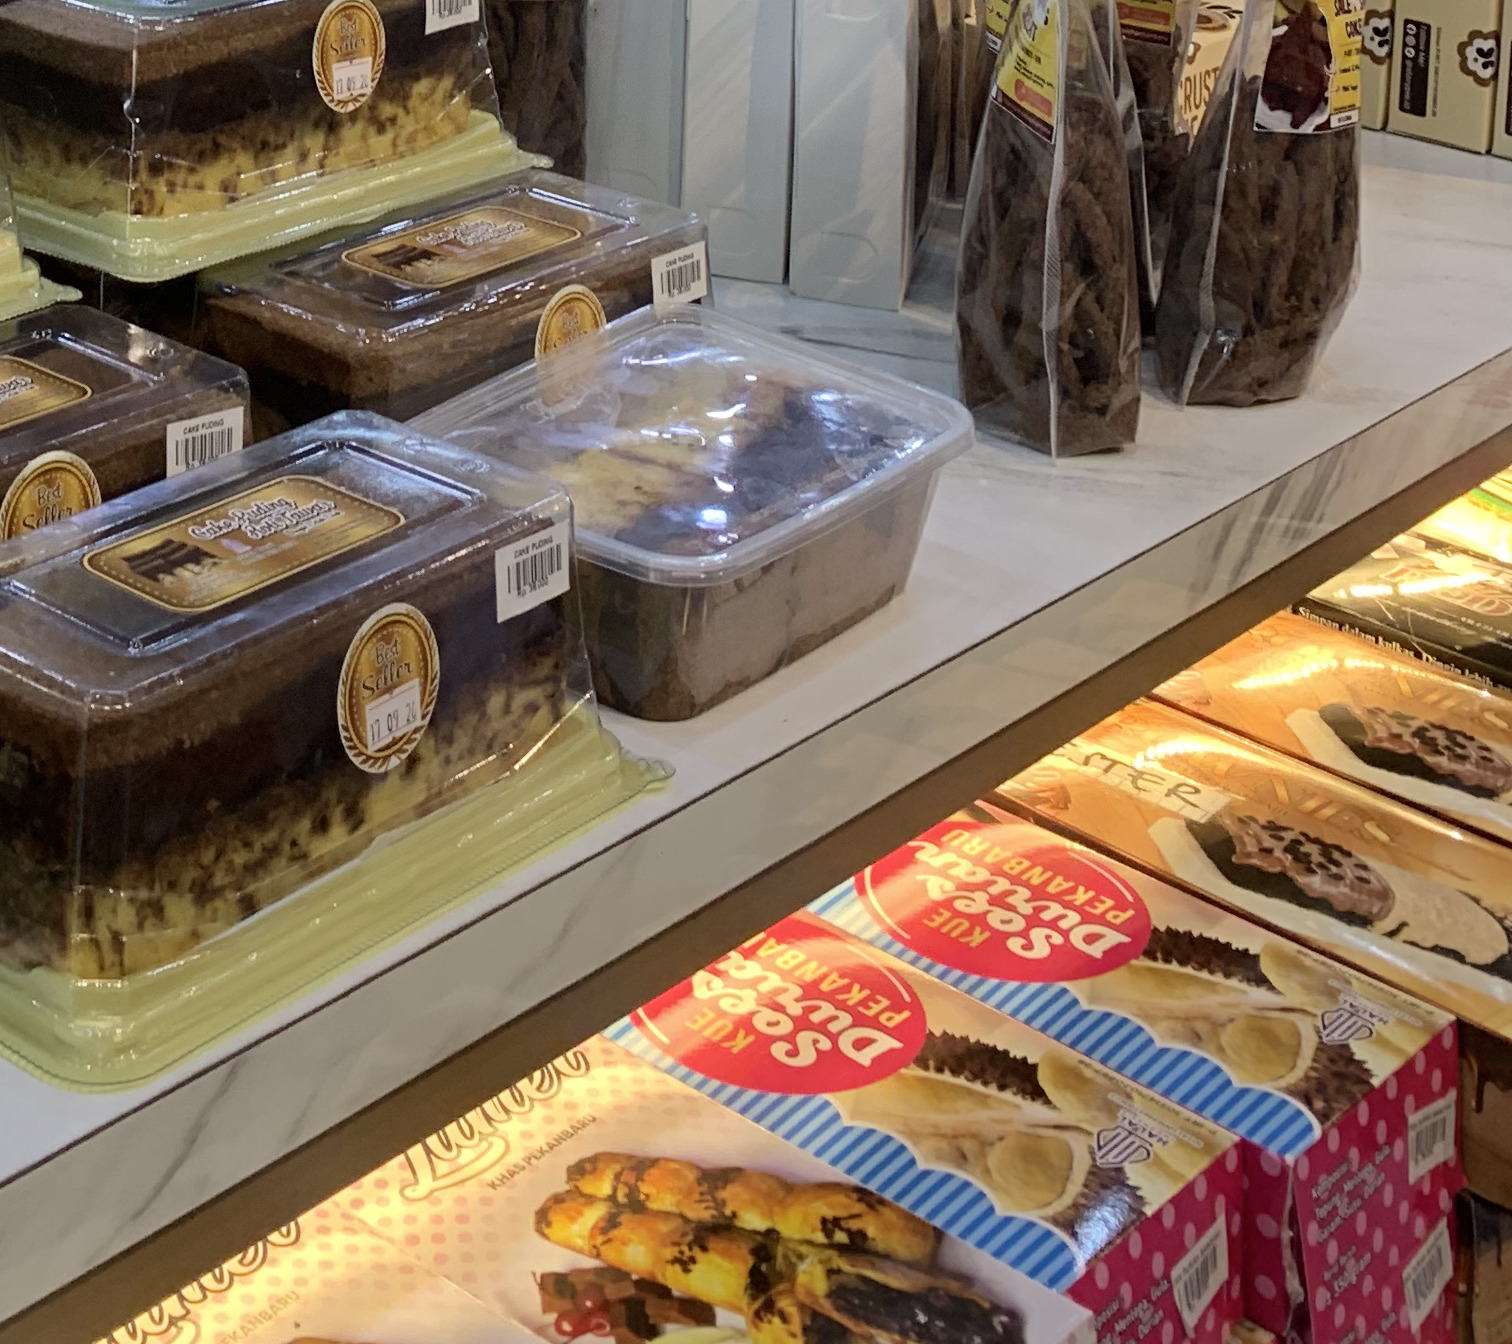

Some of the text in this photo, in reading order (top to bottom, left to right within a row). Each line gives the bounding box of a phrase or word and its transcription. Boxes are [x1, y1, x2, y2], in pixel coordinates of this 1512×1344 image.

[182, 417, 225, 437] CAKE PUDING
[35, 483, 64, 508] Best
[190, 495, 298, 541] Cake Puding
[513, 534, 556, 560] CAKE PUDING
[374, 640, 403, 667] Best
[1298, 606, 1340, 631] Simpan
[1342, 622, 1377, 644] dalam
[1422, 652, 1462, 677] Dingin
[361, 659, 415, 696] Seller
[387, 709, 403, 736] 09
[908, 840, 1134, 960] Durian
[940, 828, 1137, 927] PEKANBARU
[916, 873, 1066, 961] Soes
[922, 906, 992, 949] KUE
[685, 1003, 758, 1055] KUE
[691, 969, 835, 1070] Soes
[486, 1113, 600, 1192] KHAS PEKANBARU
